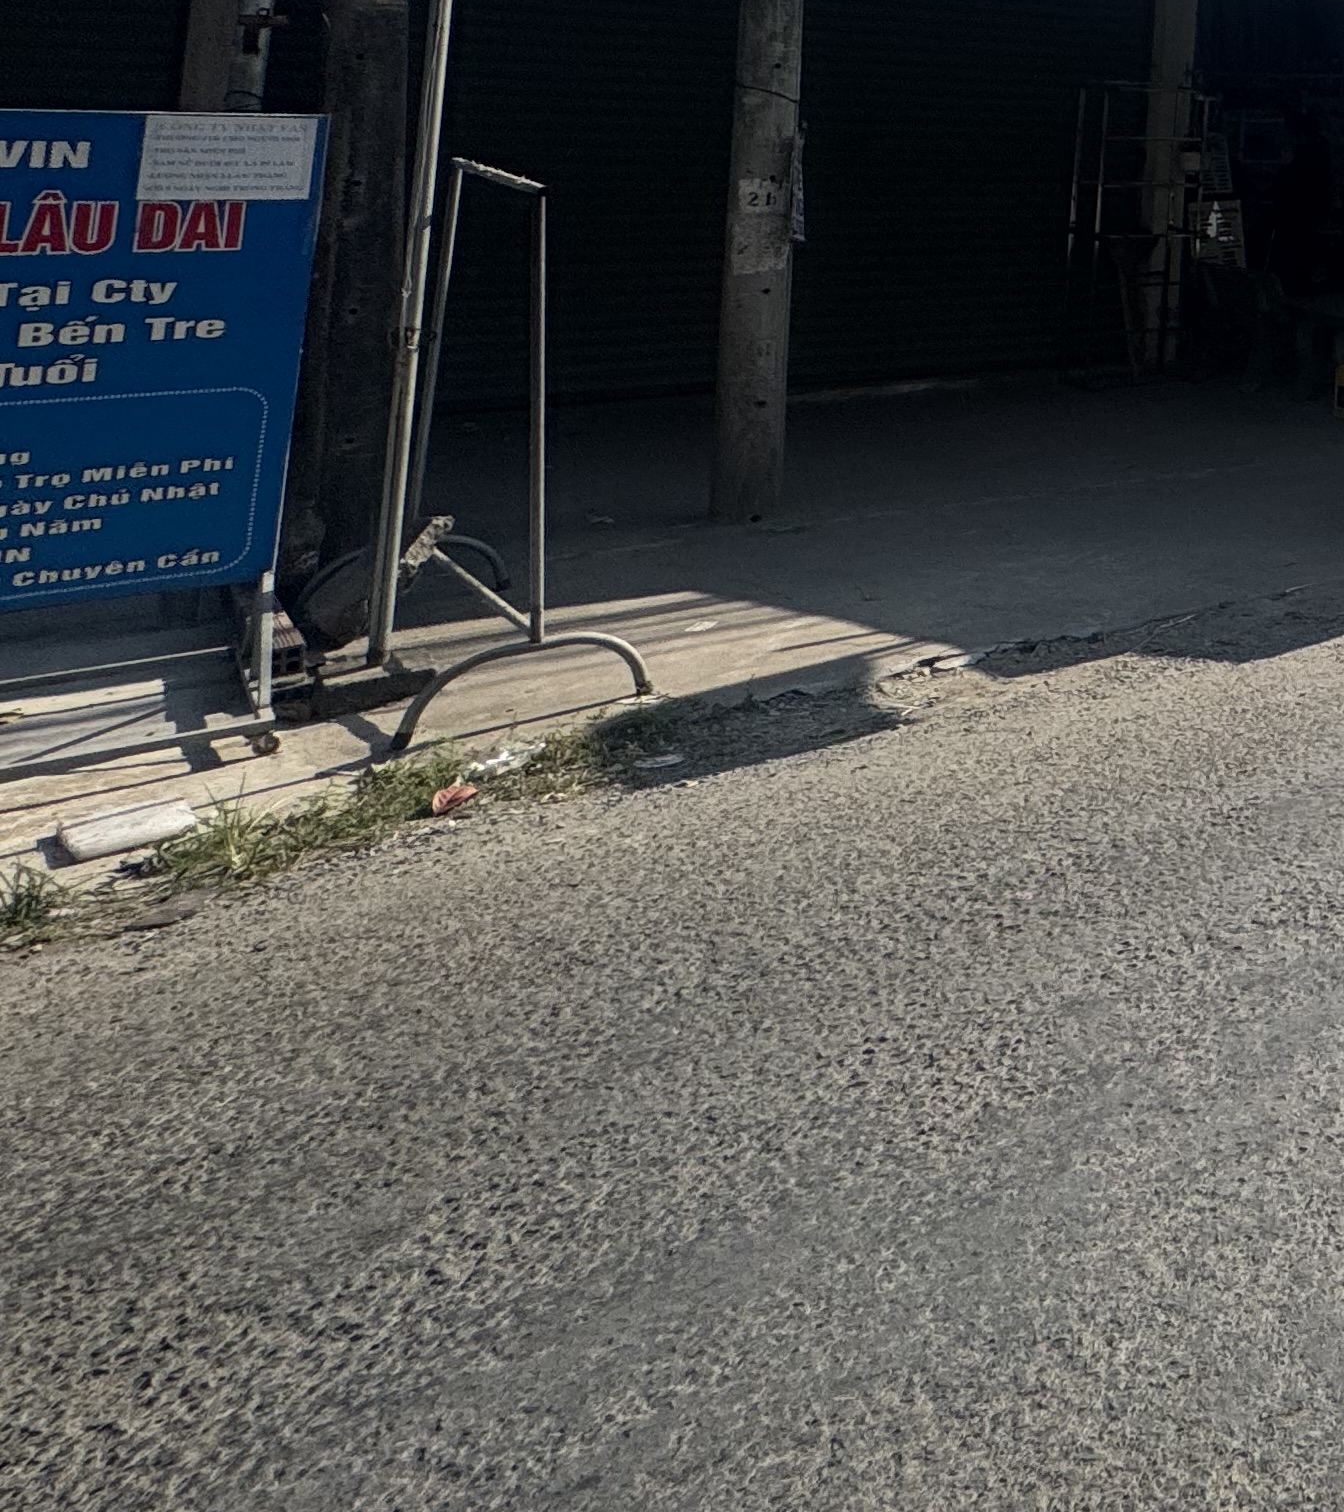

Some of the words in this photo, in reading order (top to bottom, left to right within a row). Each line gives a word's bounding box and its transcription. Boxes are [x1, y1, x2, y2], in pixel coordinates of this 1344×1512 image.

[91, 278, 179, 305] Cty
[17, 314, 127, 347] Bến
[144, 317, 227, 342] Tre
[179, 456, 236, 475] Phí
[139, 482, 220, 503] Nhật
[12, 559, 147, 588] Chuyên
